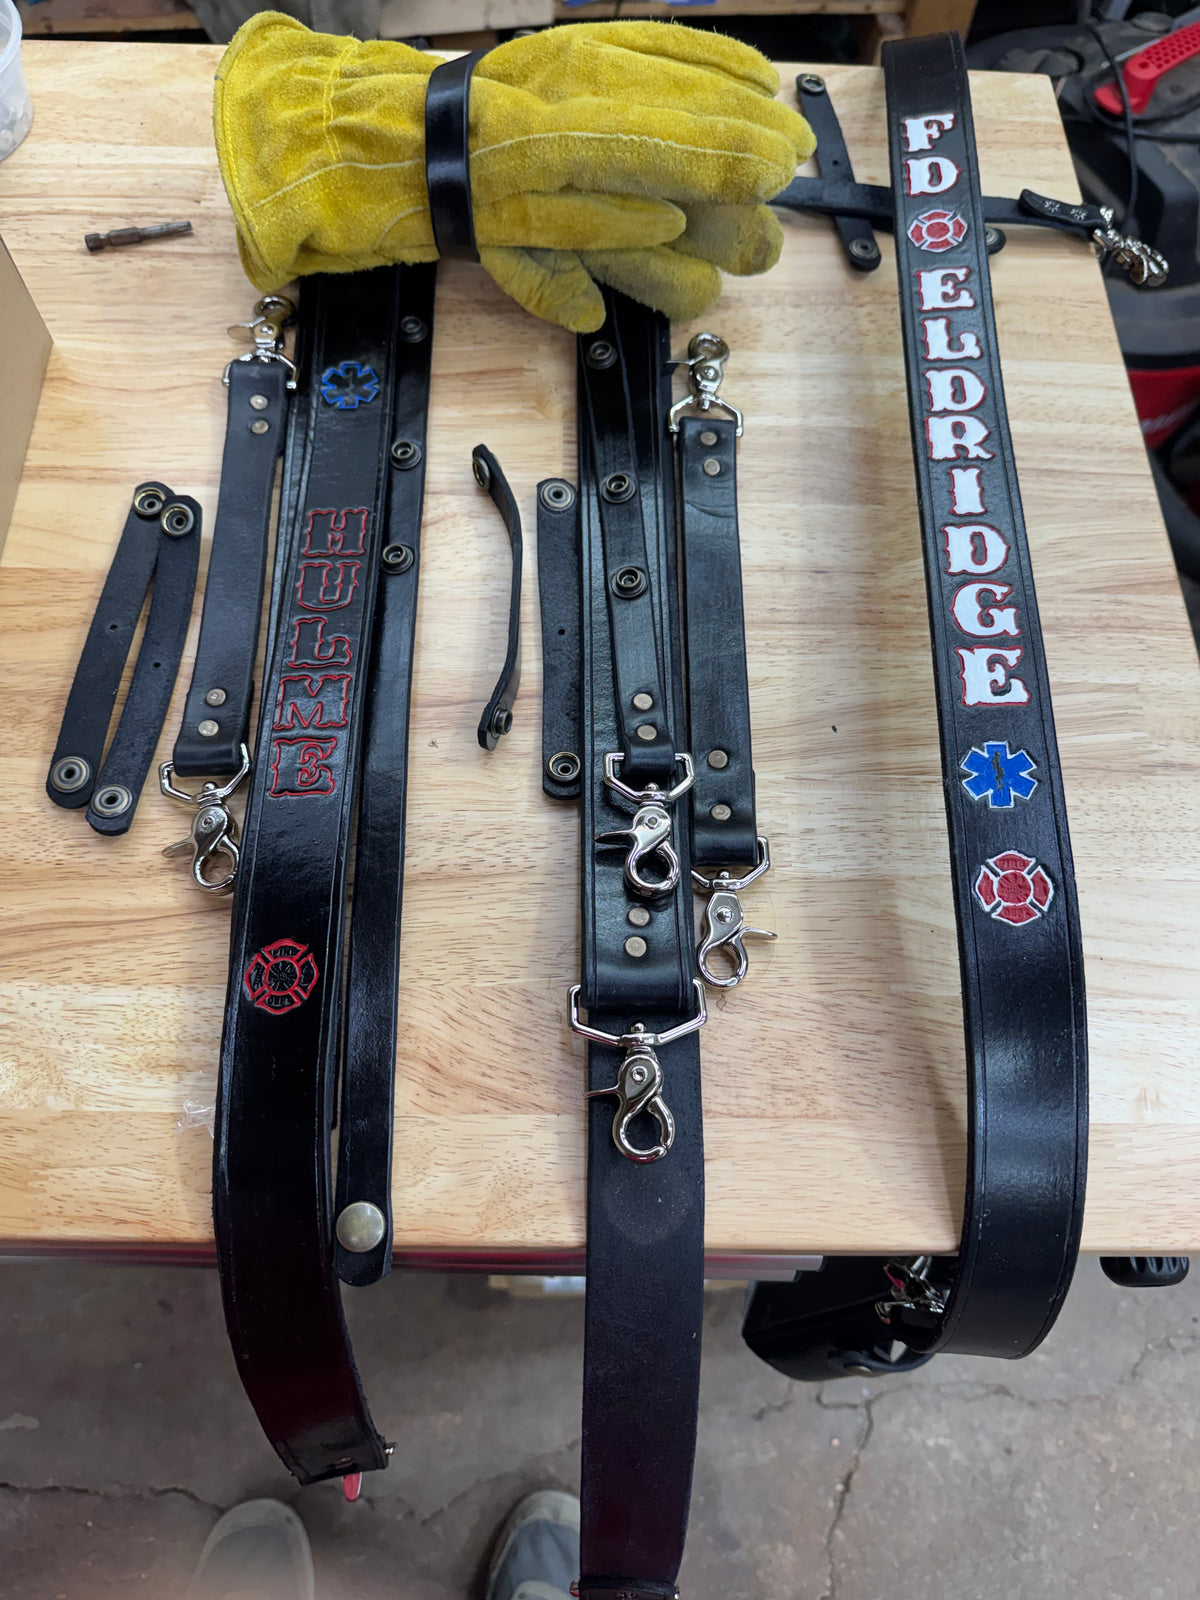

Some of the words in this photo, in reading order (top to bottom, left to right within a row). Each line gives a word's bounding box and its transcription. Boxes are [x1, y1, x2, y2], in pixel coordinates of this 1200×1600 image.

[902, 112, 962, 197] FD
[915, 266, 1031, 707] ELDRIDGE
[269, 508, 368, 797] HULME
